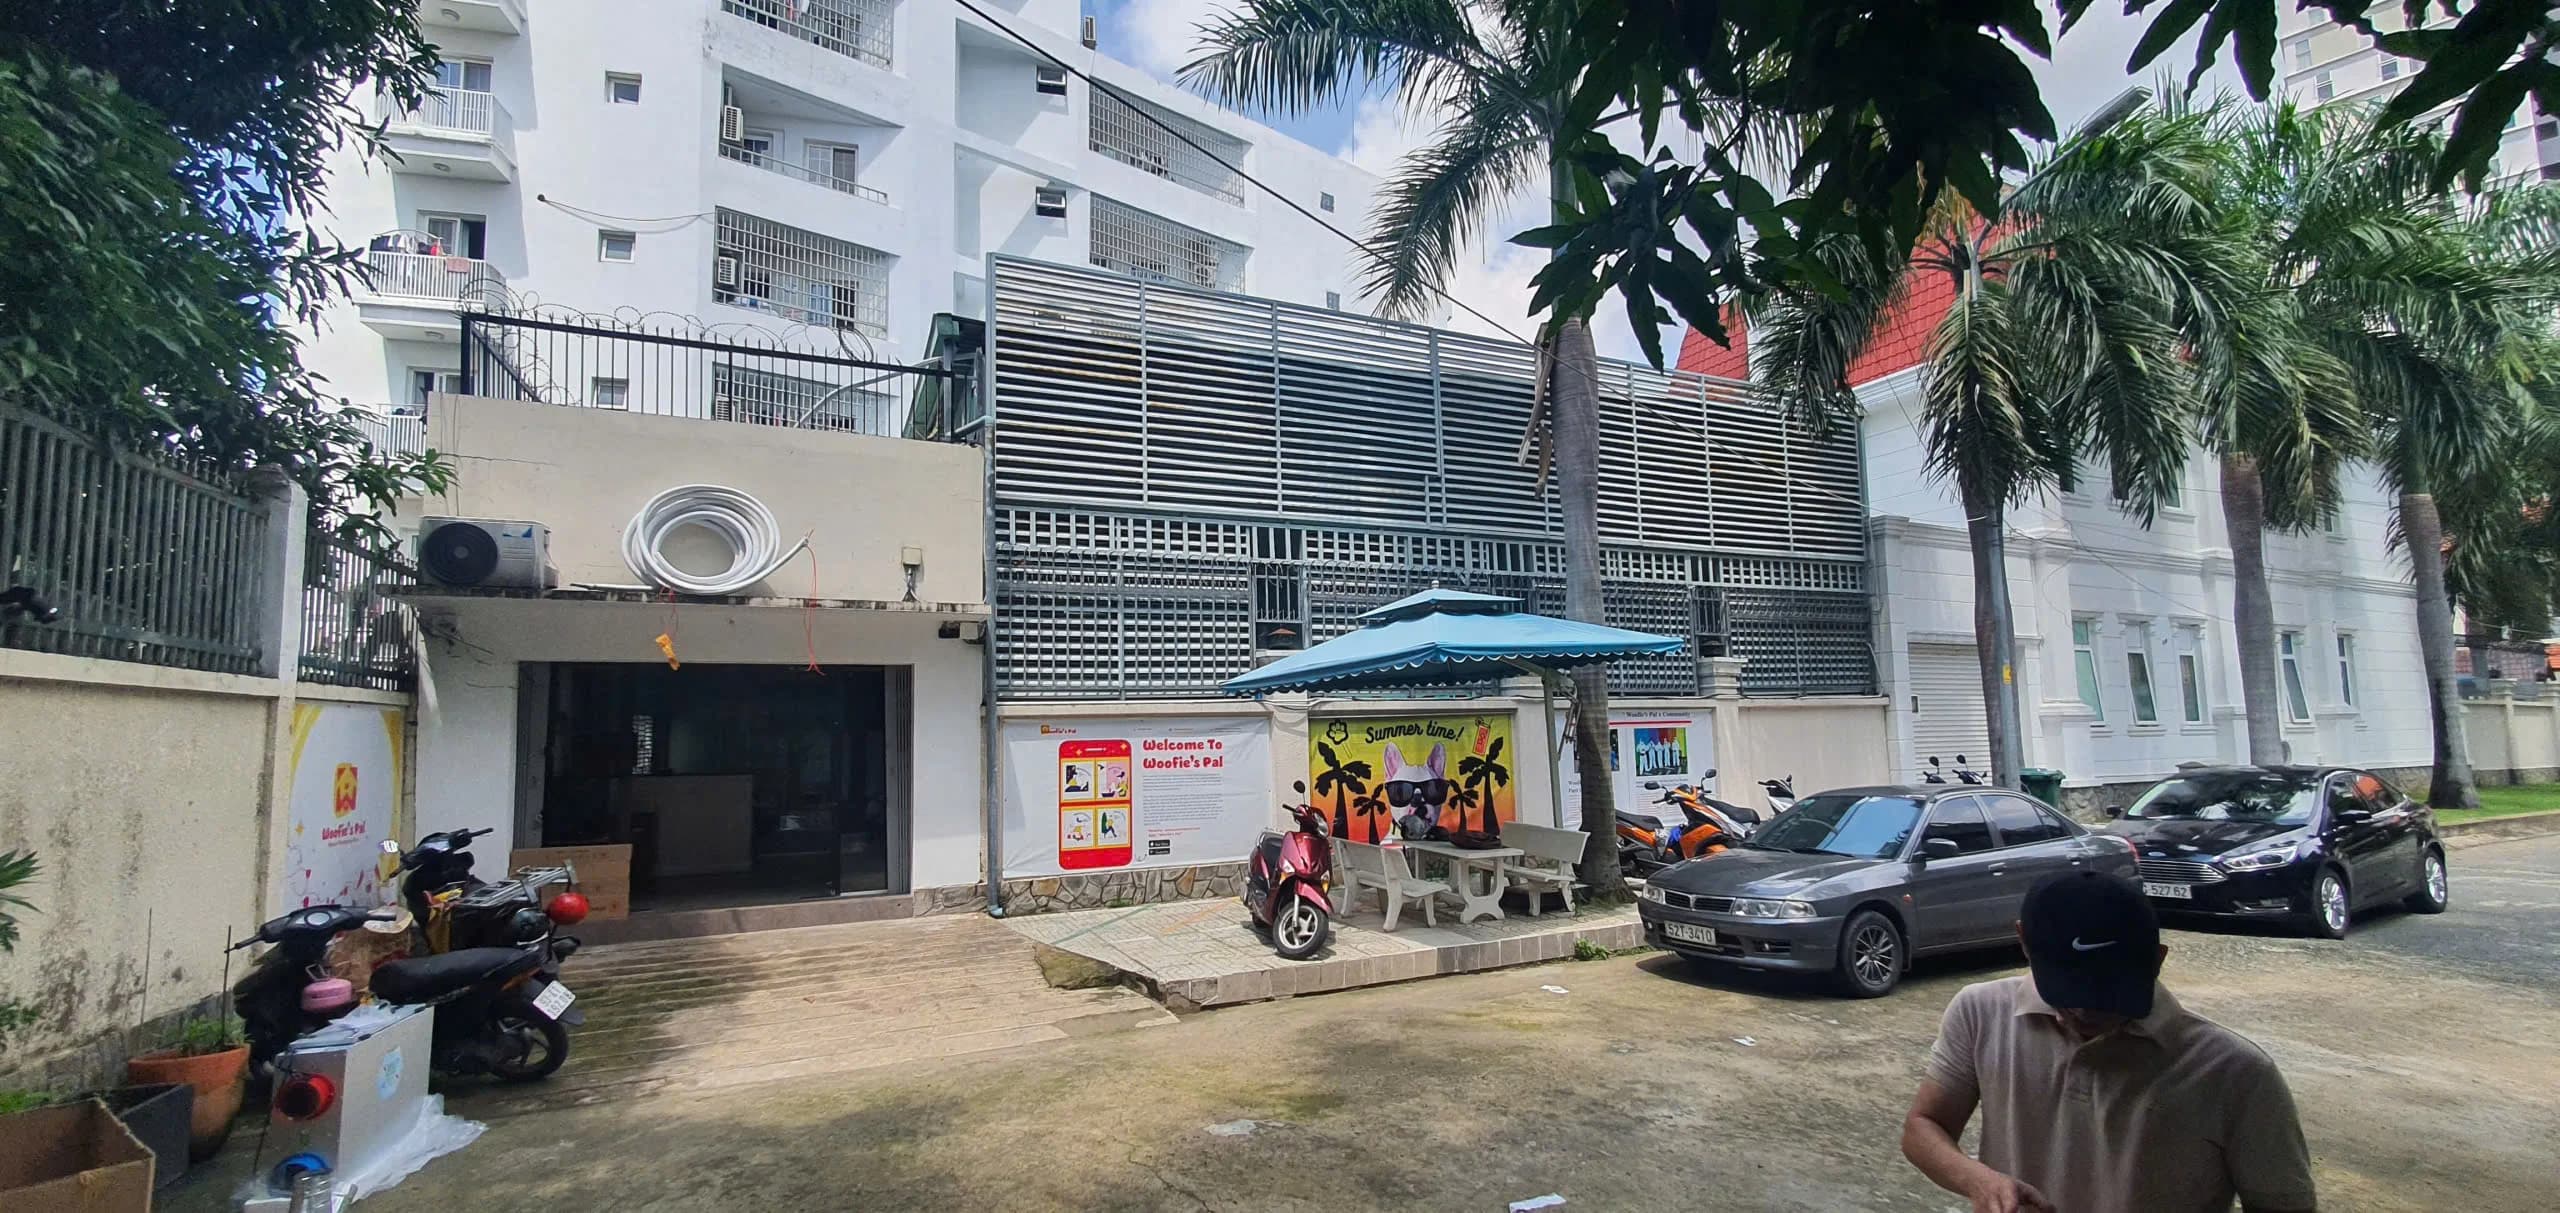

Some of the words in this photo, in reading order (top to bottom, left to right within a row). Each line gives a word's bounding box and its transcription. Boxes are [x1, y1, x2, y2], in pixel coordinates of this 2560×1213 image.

[1365, 723, 1424, 744] Summer
[1426, 720, 1465, 742] time!
[1143, 738, 1204, 751] Welcome
[1207, 738, 1223, 750] To
[1143, 755, 1201, 768] Woofie's
[1203, 755, 1223, 768] Pal
[322, 821, 353, 840] Woofie's
[354, 820, 366, 835] Pal
[1668, 922, 1713, 942] 52T-3410
